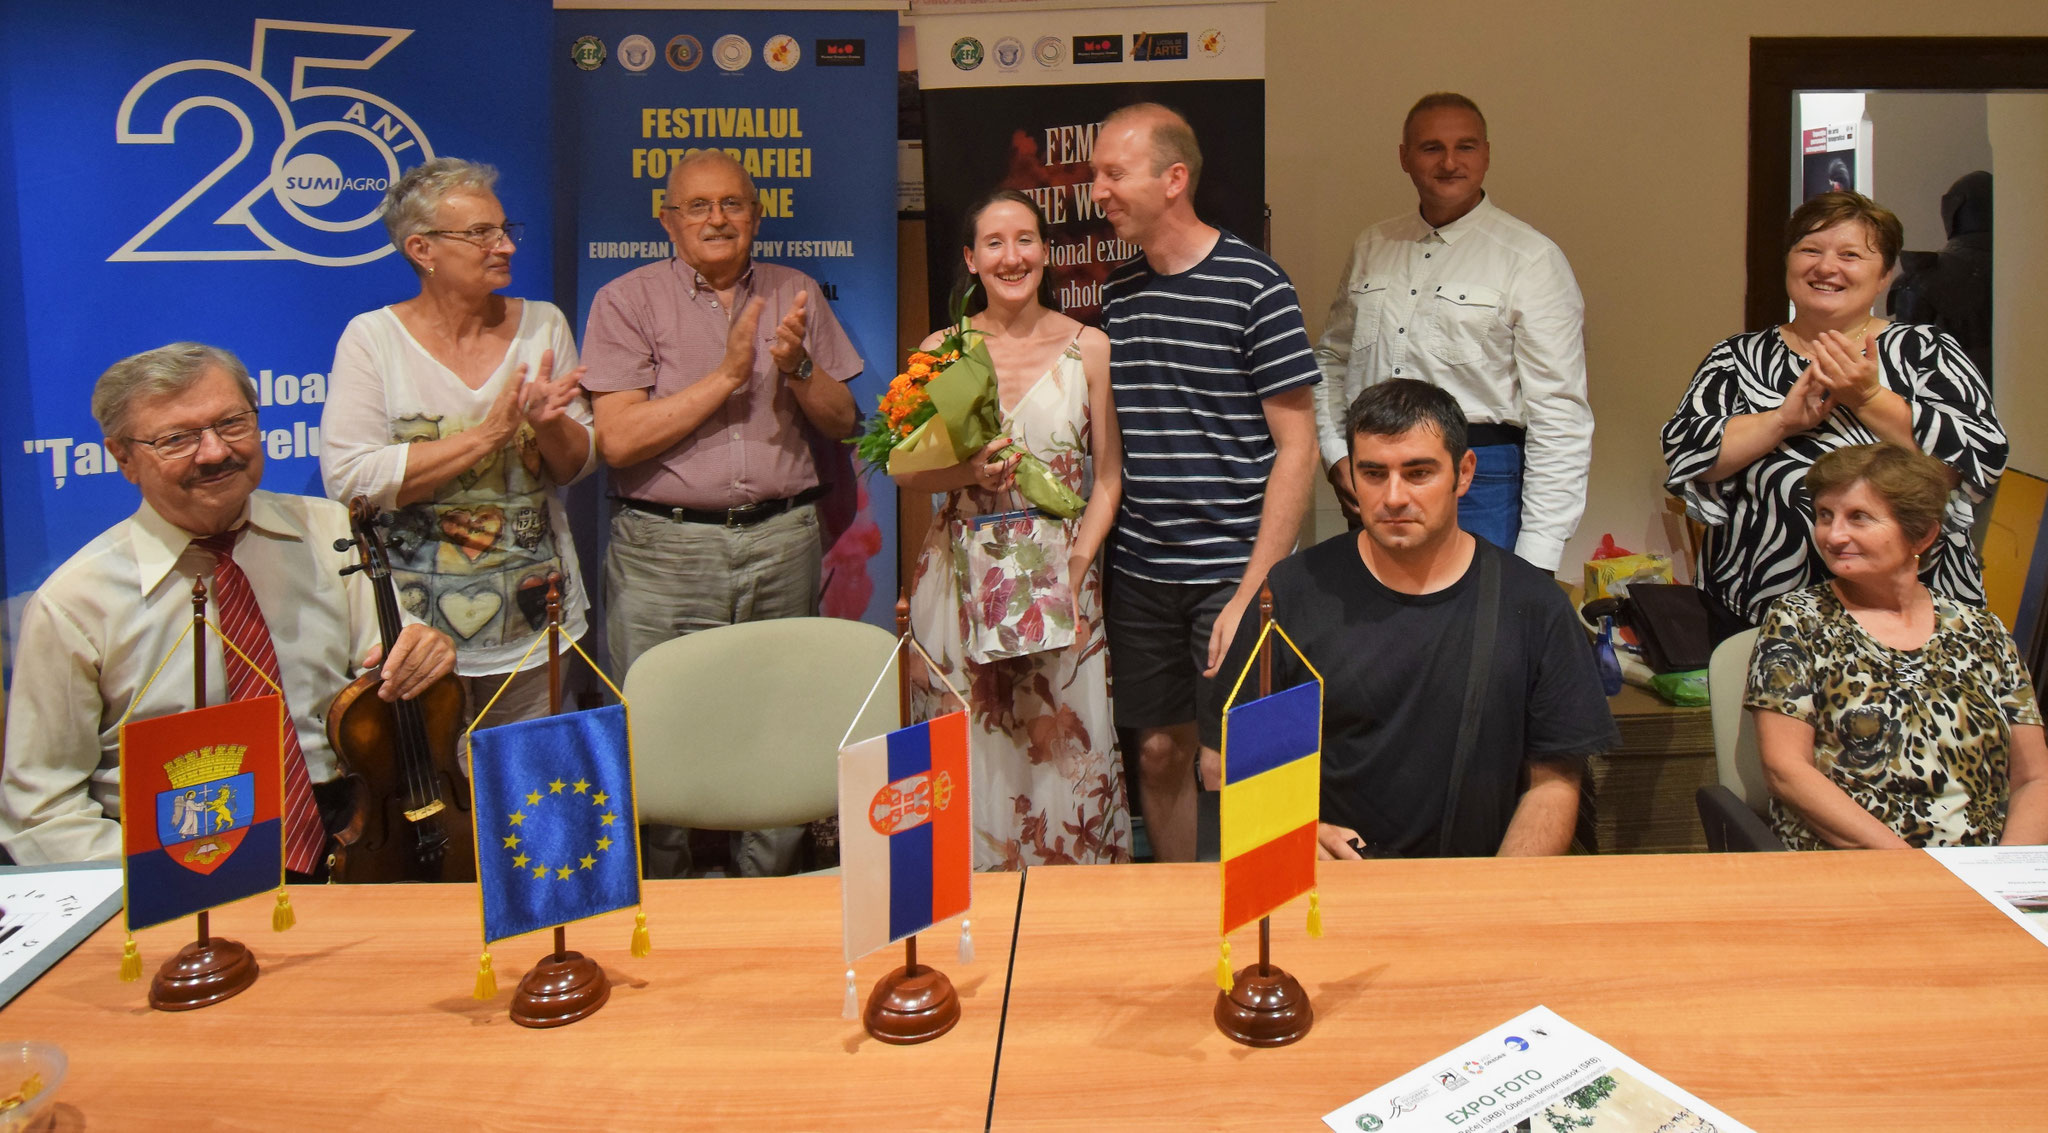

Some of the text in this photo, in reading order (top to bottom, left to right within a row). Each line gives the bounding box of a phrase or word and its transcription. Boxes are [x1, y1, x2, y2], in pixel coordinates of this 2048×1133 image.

[1154, 45, 1182, 56] ARTE
[342, 101, 415, 153] ANI
[642, 108, 803, 139] FESTIVALUL
[1022, 185, 1066, 225] HE
[589, 241, 669, 258] EUROPEAN
[787, 240, 854, 257] FESTIVAL
[249, 370, 332, 407] loa
[1578, 1056, 1602, 1071] (SRB)
[1445, 1095, 1496, 1125] EXPO
[1494, 1069, 1542, 1098] FOTO
